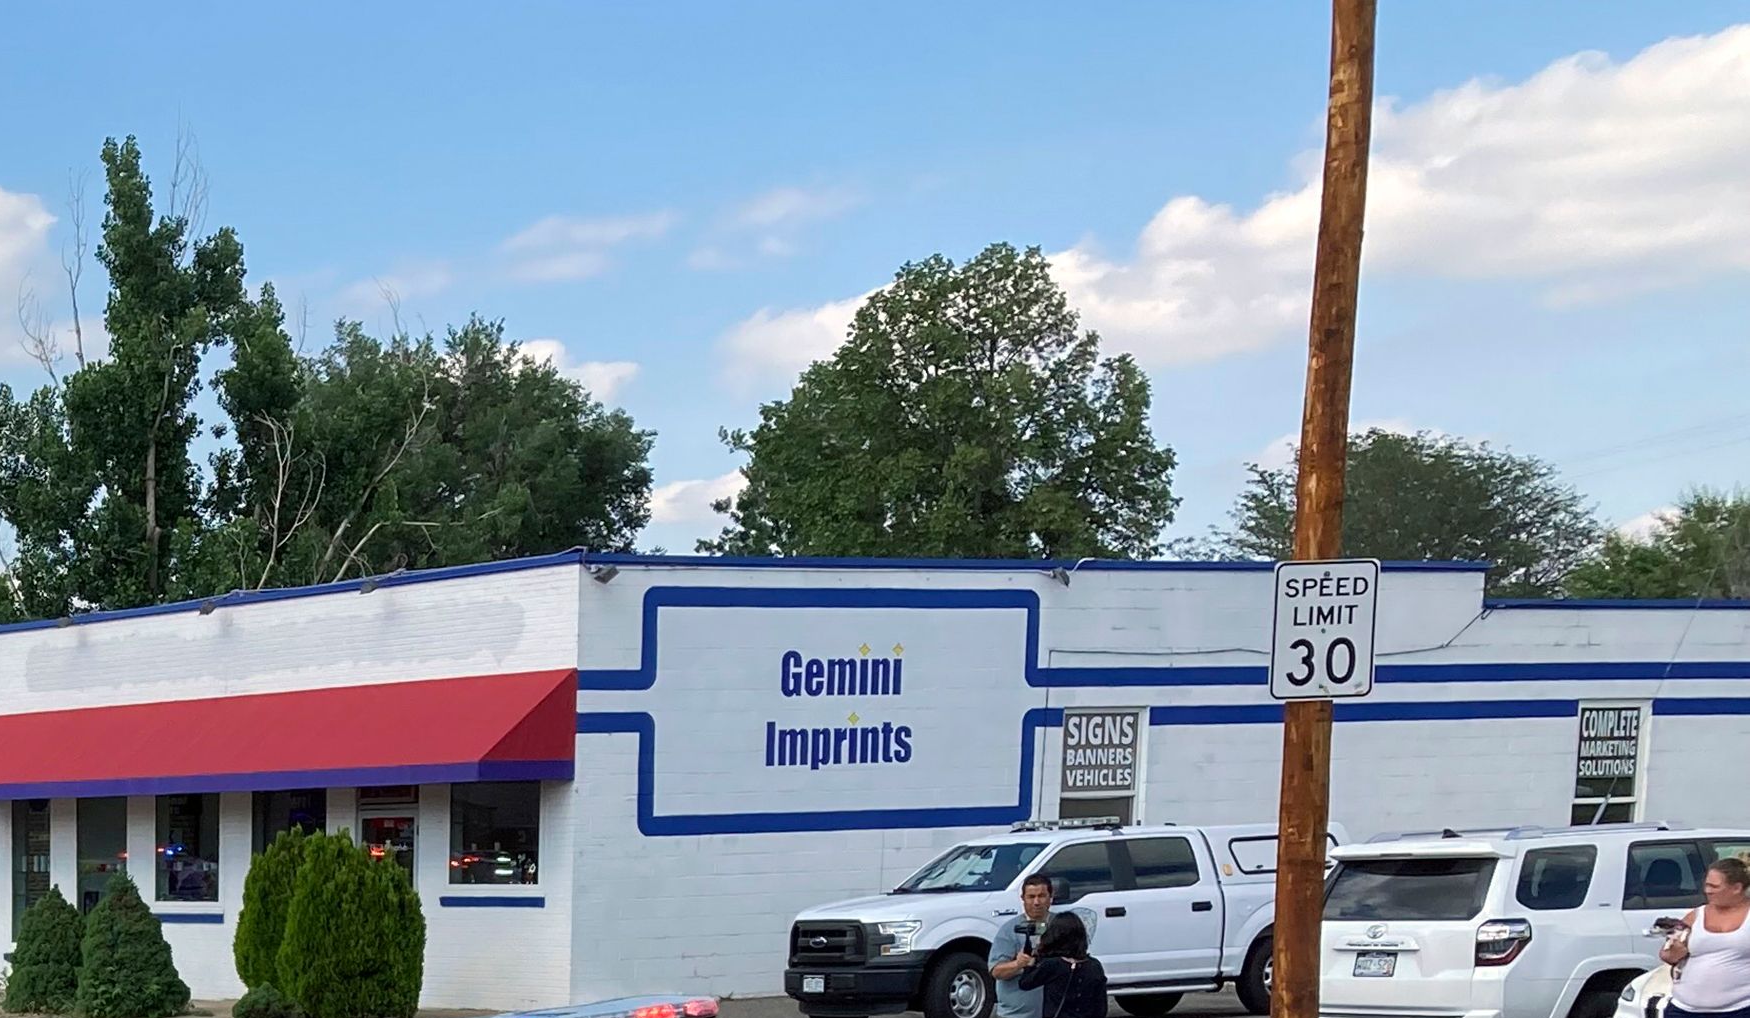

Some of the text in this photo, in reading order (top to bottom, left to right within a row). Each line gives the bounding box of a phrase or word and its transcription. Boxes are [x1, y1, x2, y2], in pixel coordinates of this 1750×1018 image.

[1285, 577, 1369, 598] SPEED
[1293, 605, 1358, 626] LIMIT
[781, 643, 904, 697] Gemini
[1286, 637, 1356, 686] 30
[1067, 715, 1134, 746] SIGNS
[1582, 710, 1638, 737] COMPLETE
[765, 712, 912, 770] Imprints
[1580, 740, 1636, 757] MARKETING
[1066, 748, 1132, 766] BANNERS
[1578, 759, 1634, 776] SOLUTIONS
[1065, 768, 1132, 787] VEHICLES
